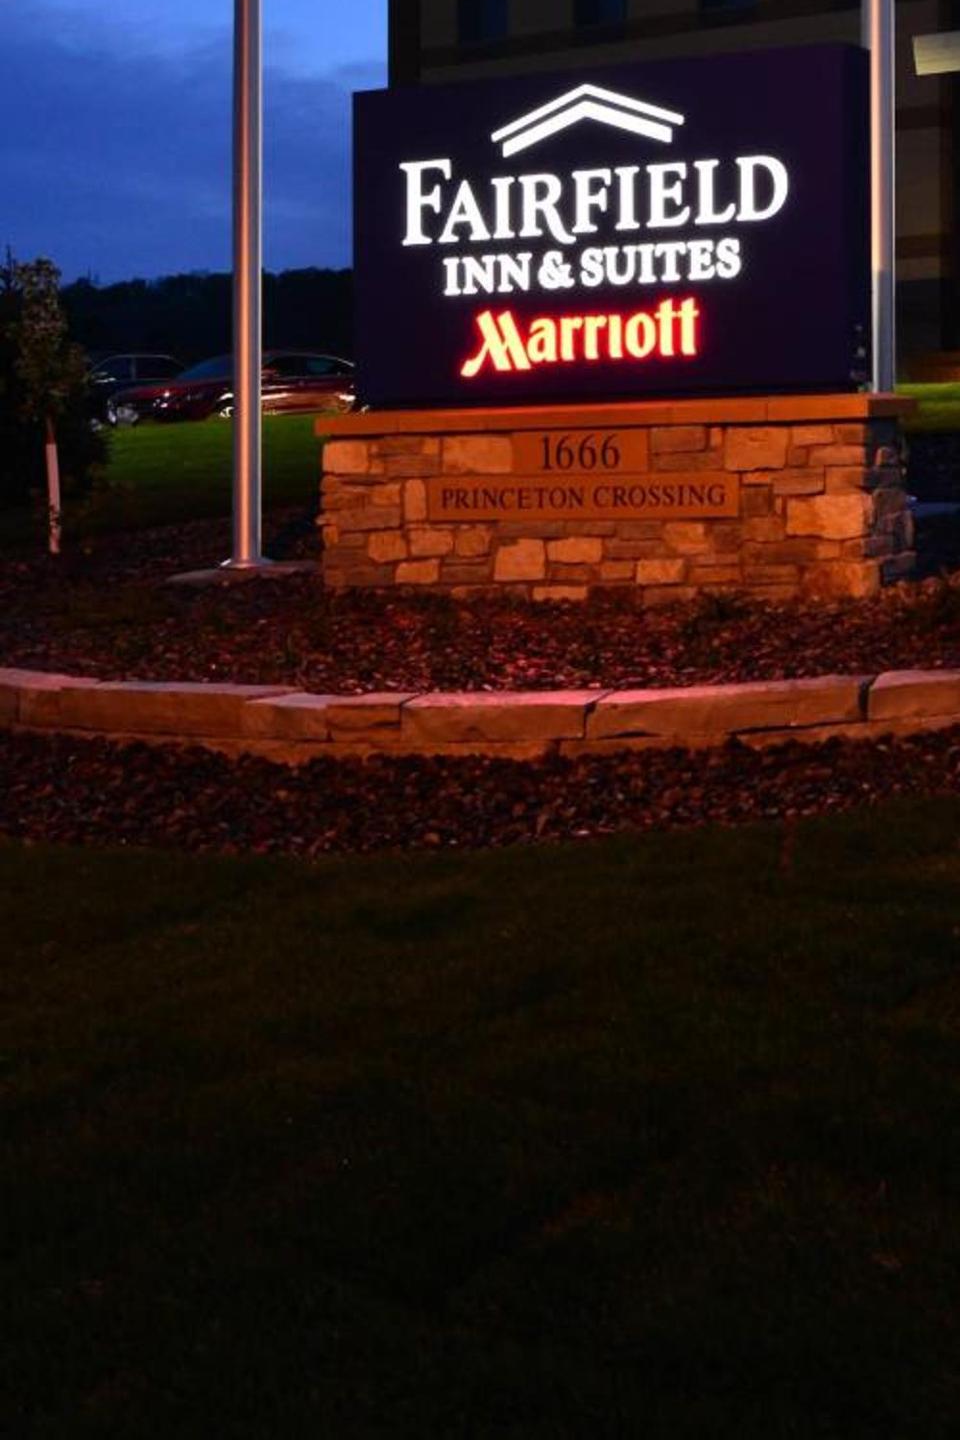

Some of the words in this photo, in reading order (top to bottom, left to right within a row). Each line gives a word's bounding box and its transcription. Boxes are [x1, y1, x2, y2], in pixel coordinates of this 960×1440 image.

[400, 153, 790, 247] FAIRFIELD
[442, 252, 533, 296] INN
[537, 250, 575, 289] &
[580, 238, 742, 287] SUITES
[459, 297, 701, 378] Marriott
[541, 434, 621, 471] 1666
[441, 486, 584, 511] PRINCETON
[592, 484, 726, 508] CROSSING
